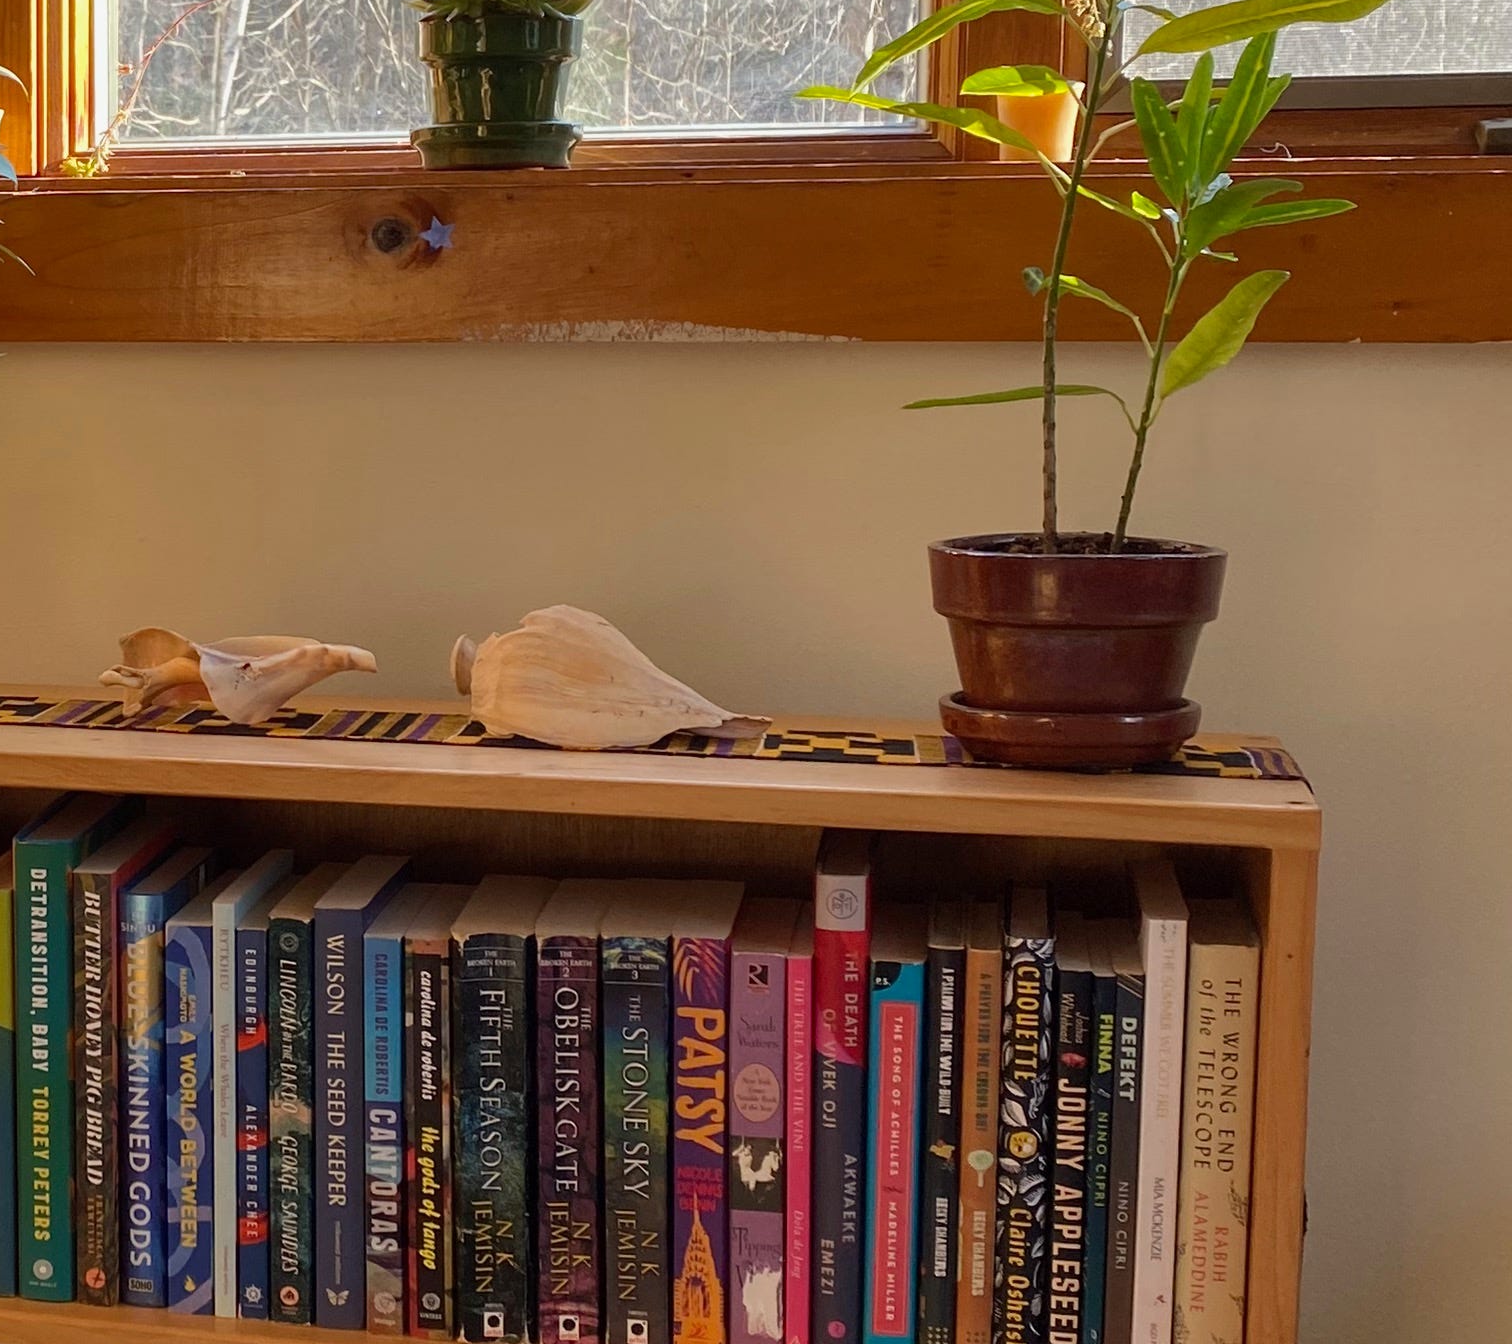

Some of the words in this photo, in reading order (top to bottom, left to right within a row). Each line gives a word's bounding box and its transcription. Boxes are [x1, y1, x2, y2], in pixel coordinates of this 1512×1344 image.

[29, 868, 48, 1016] DETRANSITION,
[83, 891, 102, 981] BUTTER
[844, 952, 859, 982] THE
[245, 948, 257, 1035] EDINBURGH
[326, 934, 345, 1015] WILSON
[1198, 978, 1217, 999] of
[1224, 977, 1242, 1017] THE
[84, 982, 103, 1062] HONEY
[179, 1029, 197, 1045] A
[479, 989, 506, 1067] FIFTH
[580, 1008, 592, 1031] THE
[628, 994, 641, 1023] THE
[822, 1008, 836, 1031] OF
[844, 993, 859, 1048] DEATH
[893, 1015, 903, 1041] THE
[1014, 965, 1041, 1081] CHOUETTE
[1199, 1007, 1216, 1036] the
[31, 1024, 48, 1072] BABY
[126, 942, 151, 1173] BLUE-SKINNED
[327, 1031, 345, 1070] THE
[554, 986, 580, 1113] OBELISK
[822, 1040, 836, 1091] VIVEK
[892, 1047, 902, 1084] SONG
[1097, 1014, 1114, 1074] FINNA
[1119, 1016, 1138, 1102] DEFEKT
[1219, 1031, 1240, 1114] WRONG
[85, 1063, 103, 1105] PIG
[179, 1052, 198, 1133] WORLD
[327, 1078, 346, 1127] SEED
[622, 1027, 649, 1133] STONE
[674, 1006, 726, 1155] PATSY
[891, 1089, 901, 1106] OF
[1193, 1049, 1216, 1170] TELESCOPE
[32, 1086, 49, 1160] TORREY
[86, 1108, 104, 1186] BREAD
[245, 1104, 258, 1192] ALEXANDER
[479, 1077, 507, 1191] SEASON
[823, 1100, 837, 1130] OJI
[889, 1111, 901, 1176] ACHILLES
[1055, 1078, 1087, 1172] JONNY
[1096, 1112, 1109, 1155] NINO
[328, 1134, 346, 1206] KEEPER
[368, 1108, 399, 1253] CANTORAS
[555, 1118, 579, 1192] GATE
[623, 1141, 650, 1200] SKY
[1216, 1129, 1236, 1173] END
[33, 1167, 51, 1242] PETERS
[180, 1139, 198, 1248] BETWEEN
[841, 1154, 858, 1243] AKWAEKE
[1094, 1163, 1107, 1207] CIPRI
[1116, 1181, 1130, 1223] NINO
[128, 1182, 152, 1268] GODS
[246, 1200, 259, 1238] CHEE
[471, 1200, 494, 1294] JEMISIN
[546, 1202, 570, 1296] JEMISIN
[887, 1201, 897, 1269] MADELINE
[1007, 1207, 1033, 1267] Claire
[1115, 1229, 1129, 1270] CIPRI
[1190, 1191, 1209, 1313] ALAMEDDINE
[129, 1280, 153, 1291] SOHO
[614, 1209, 637, 1302] JEMISIN
[820, 1238, 835, 1296] EMEZI
[1212, 1226, 1229, 1283] RABIH
[885, 1272, 896, 1322] MILLER
